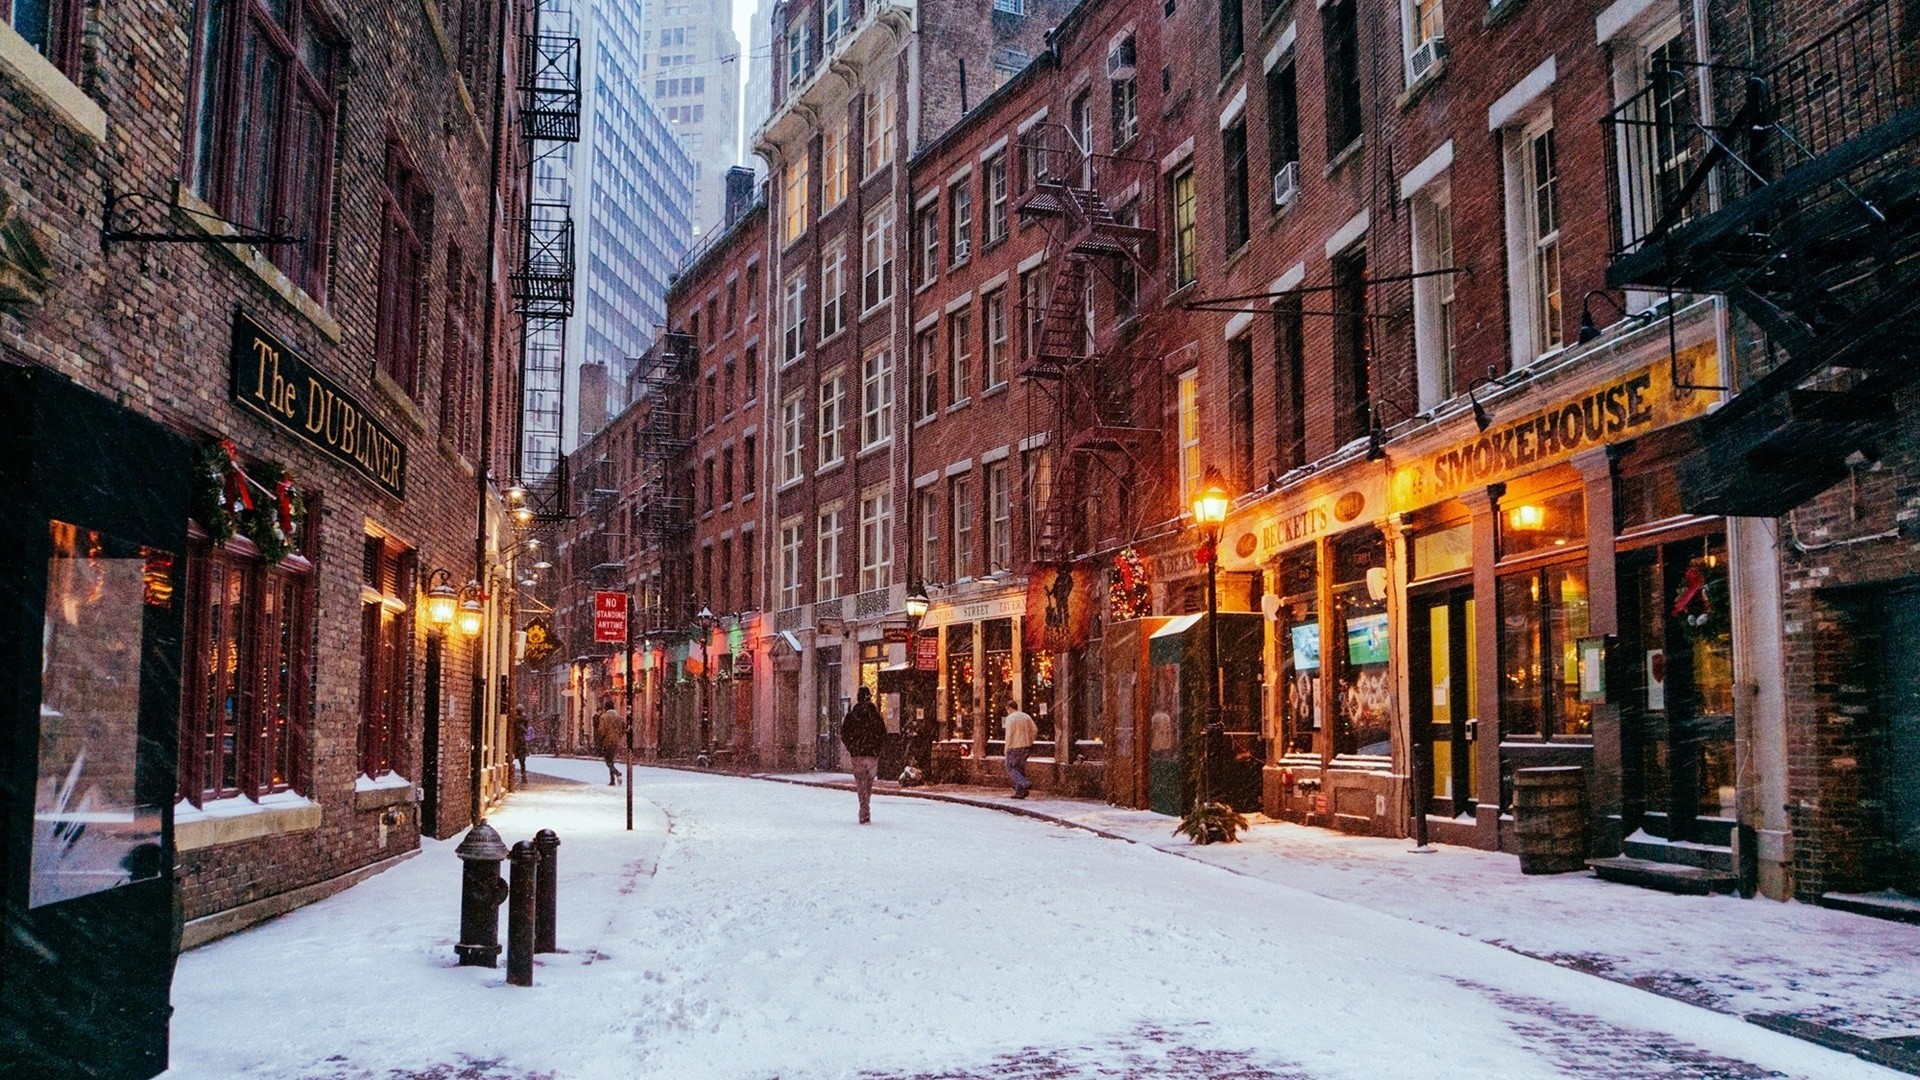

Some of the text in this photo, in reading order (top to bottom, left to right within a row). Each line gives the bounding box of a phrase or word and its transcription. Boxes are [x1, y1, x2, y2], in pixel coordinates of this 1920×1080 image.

[252, 336, 400, 491] The DUBLINER
[1433, 372, 1653, 497] SMOKEHOUSE
[1262, 504, 1328, 550] BECKETT'S
[605, 597, 617, 608] NO
[596, 610, 626, 620] STANDING
[963, 604, 990, 617] STREET
[598, 620, 624, 630] ANYTIME
